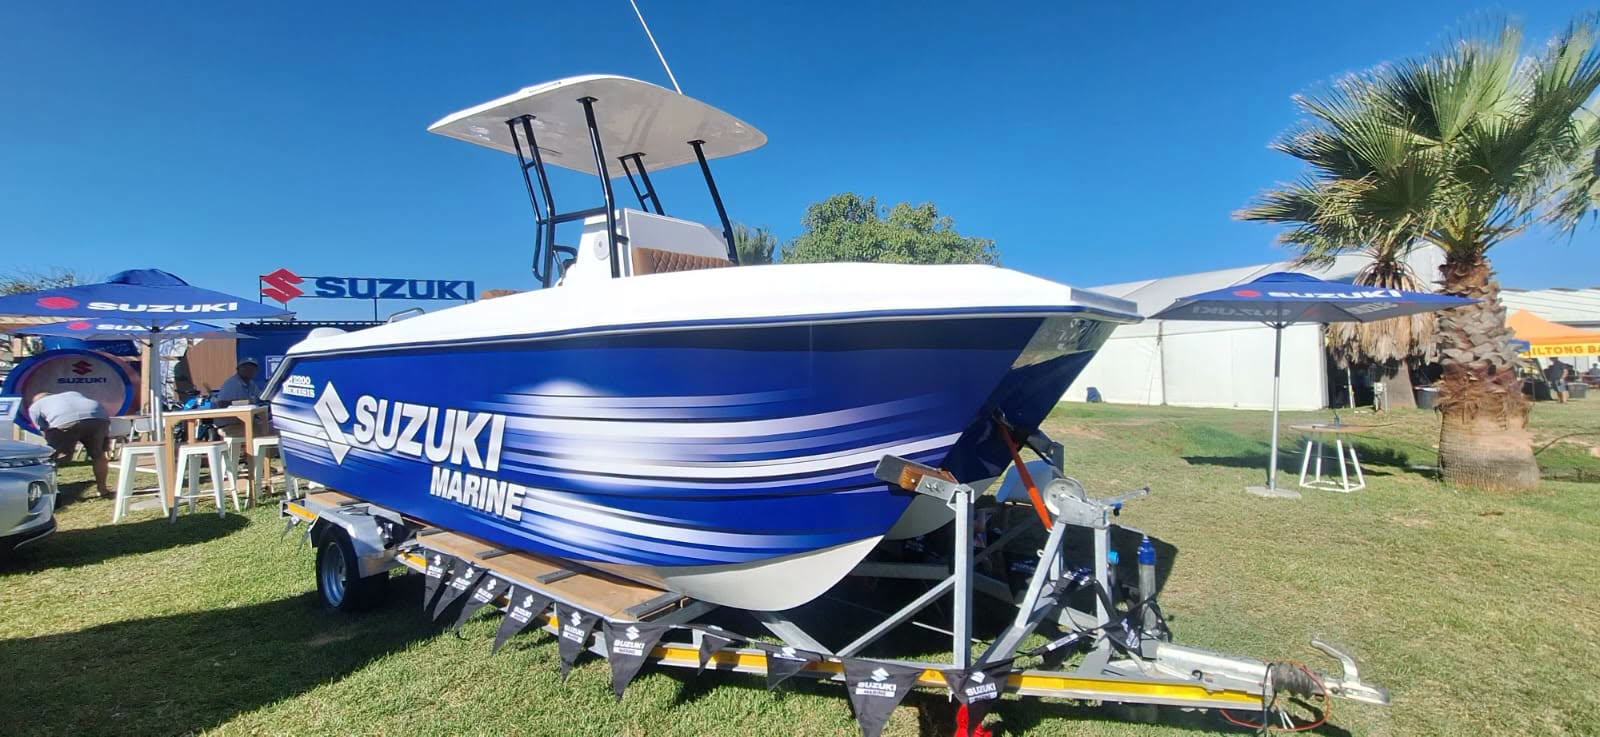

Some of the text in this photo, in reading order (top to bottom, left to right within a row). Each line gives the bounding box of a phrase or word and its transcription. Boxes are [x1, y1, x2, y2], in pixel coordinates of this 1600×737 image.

[315, 276, 476, 300] SUZUKI
[1267, 290, 1403, 300] SUZUKI
[87, 301, 239, 313] SUZUKI
[57, 376, 108, 384] SUZUKI
[353, 395, 506, 472] SUZUKI
[430, 466, 527, 522] MARINE
[857, 681, 897, 691] SUZUKI
[965, 682, 997, 697] SUZUKI
